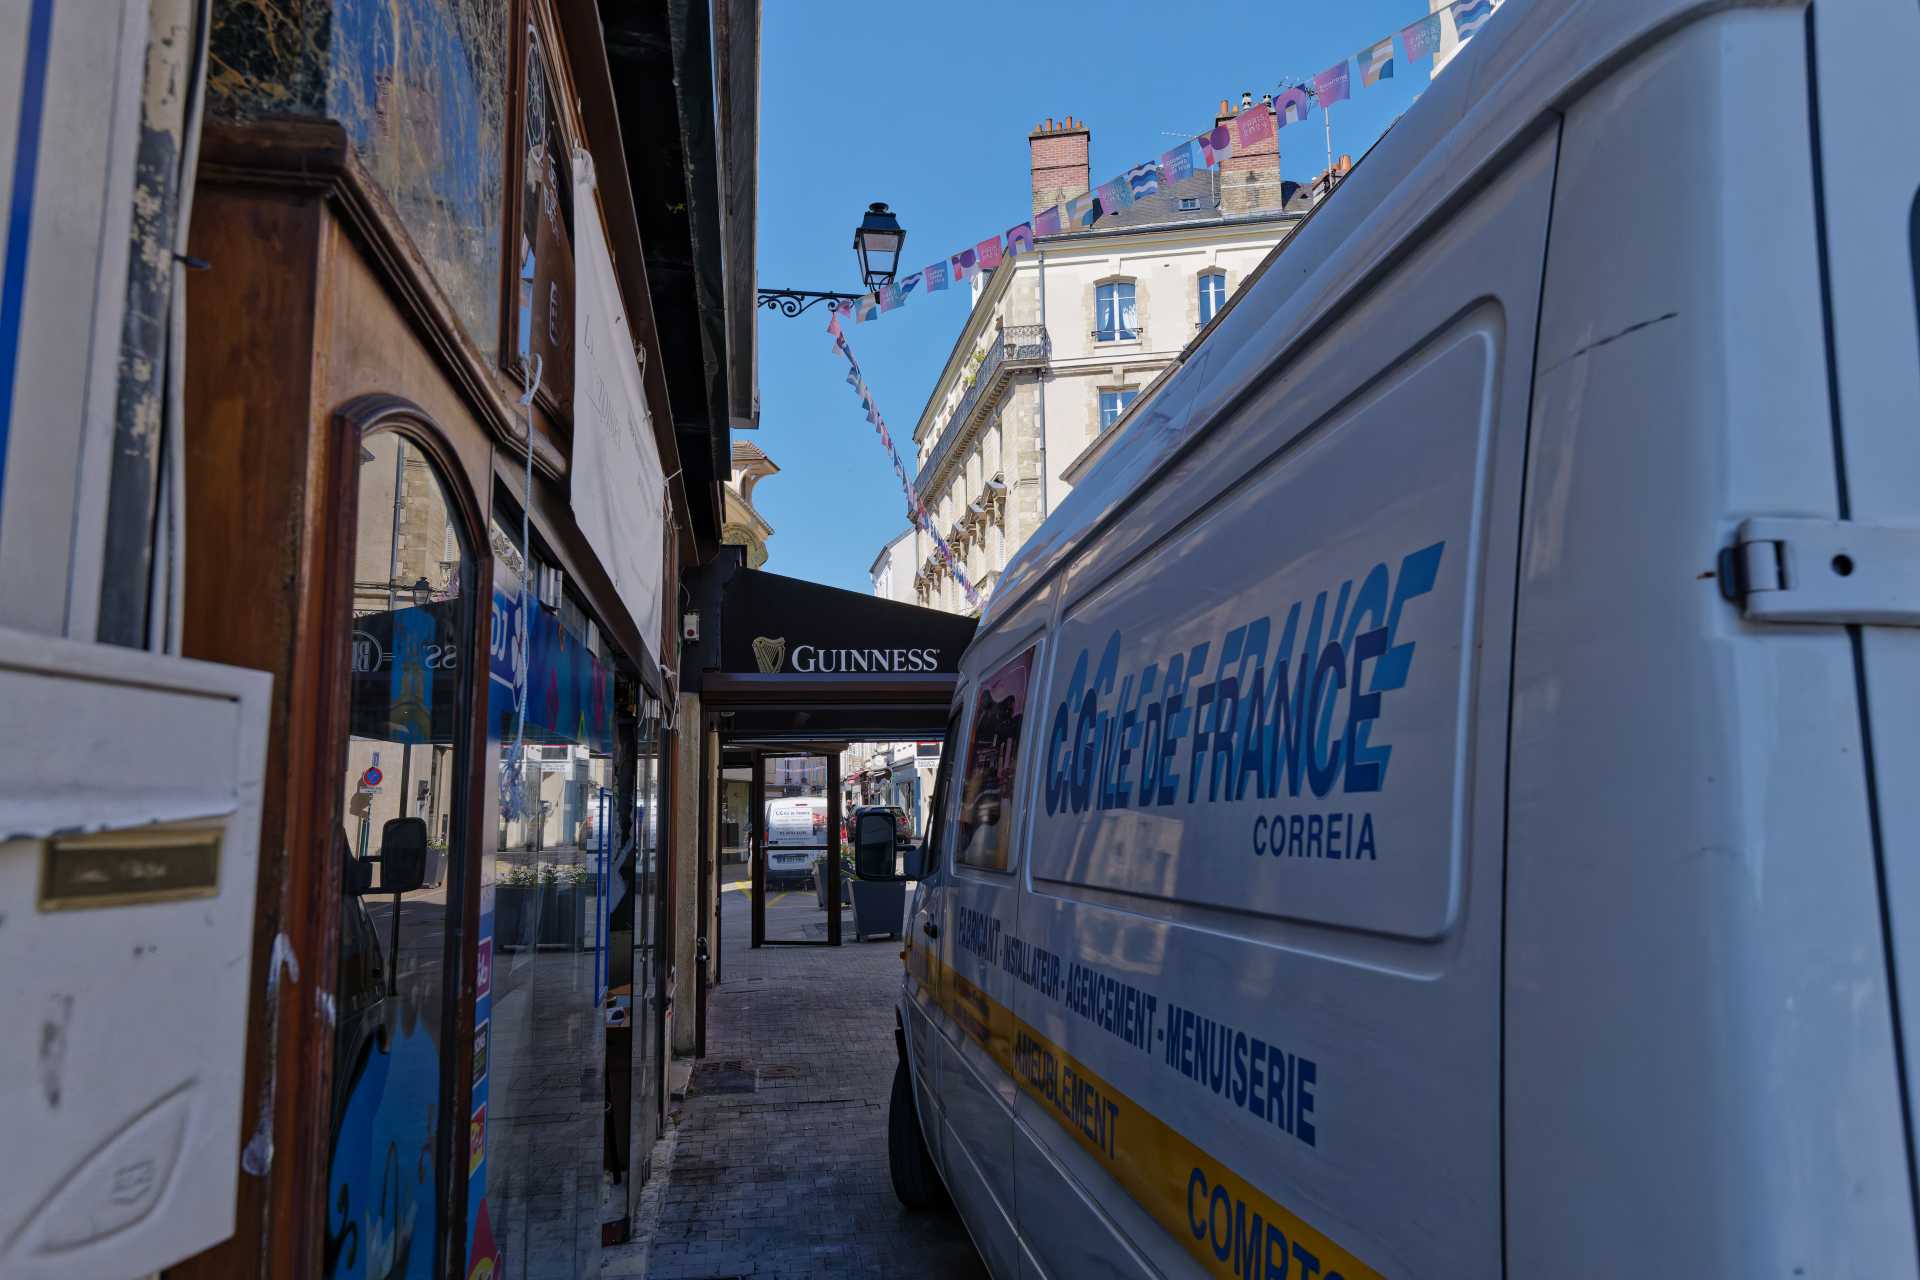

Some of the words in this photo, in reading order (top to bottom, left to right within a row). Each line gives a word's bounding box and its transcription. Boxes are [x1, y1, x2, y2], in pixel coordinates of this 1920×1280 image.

[791, 645, 939, 673] GUINNESS
[1138, 694, 1183, 808] DE
[1188, 627, 1389, 804] FRANCE
[1253, 812, 1376, 861] CORREIA
[1003, 934, 1060, 1001] INSTALLATEUR
[1066, 962, 1157, 1055] AGENCEMENT
[1166, 1004, 1317, 1147] MENUISERIE
[1187, 1167, 1346, 1280] COMPT
